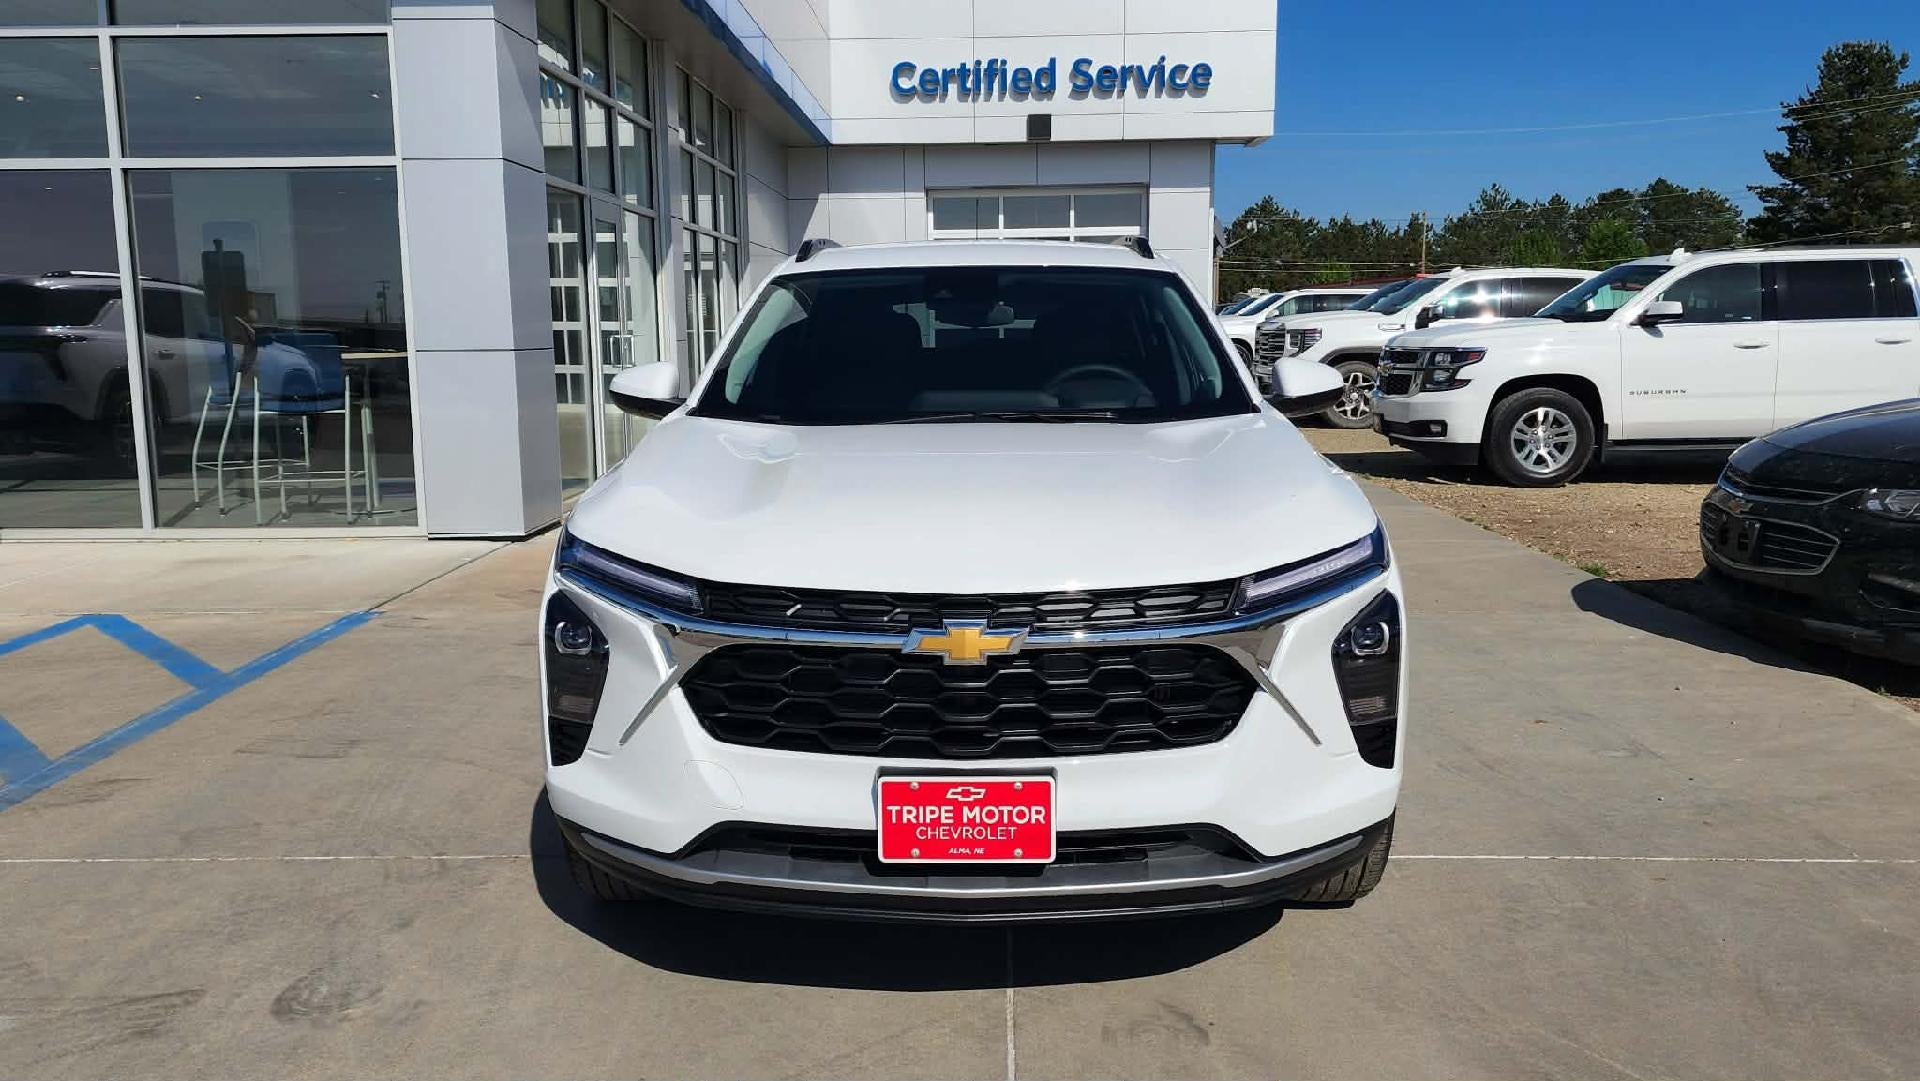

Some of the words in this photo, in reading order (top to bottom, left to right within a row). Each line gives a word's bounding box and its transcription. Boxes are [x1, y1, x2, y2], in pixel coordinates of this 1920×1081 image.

[891, 57, 1057, 95] Certified
[1072, 55, 1213, 92] Service
[887, 805, 954, 824] TRIPE
[963, 805, 1046, 824] MOTOR
[916, 826, 1017, 840] CHEVROLET
[948, 847, 971, 855] ALMA,
